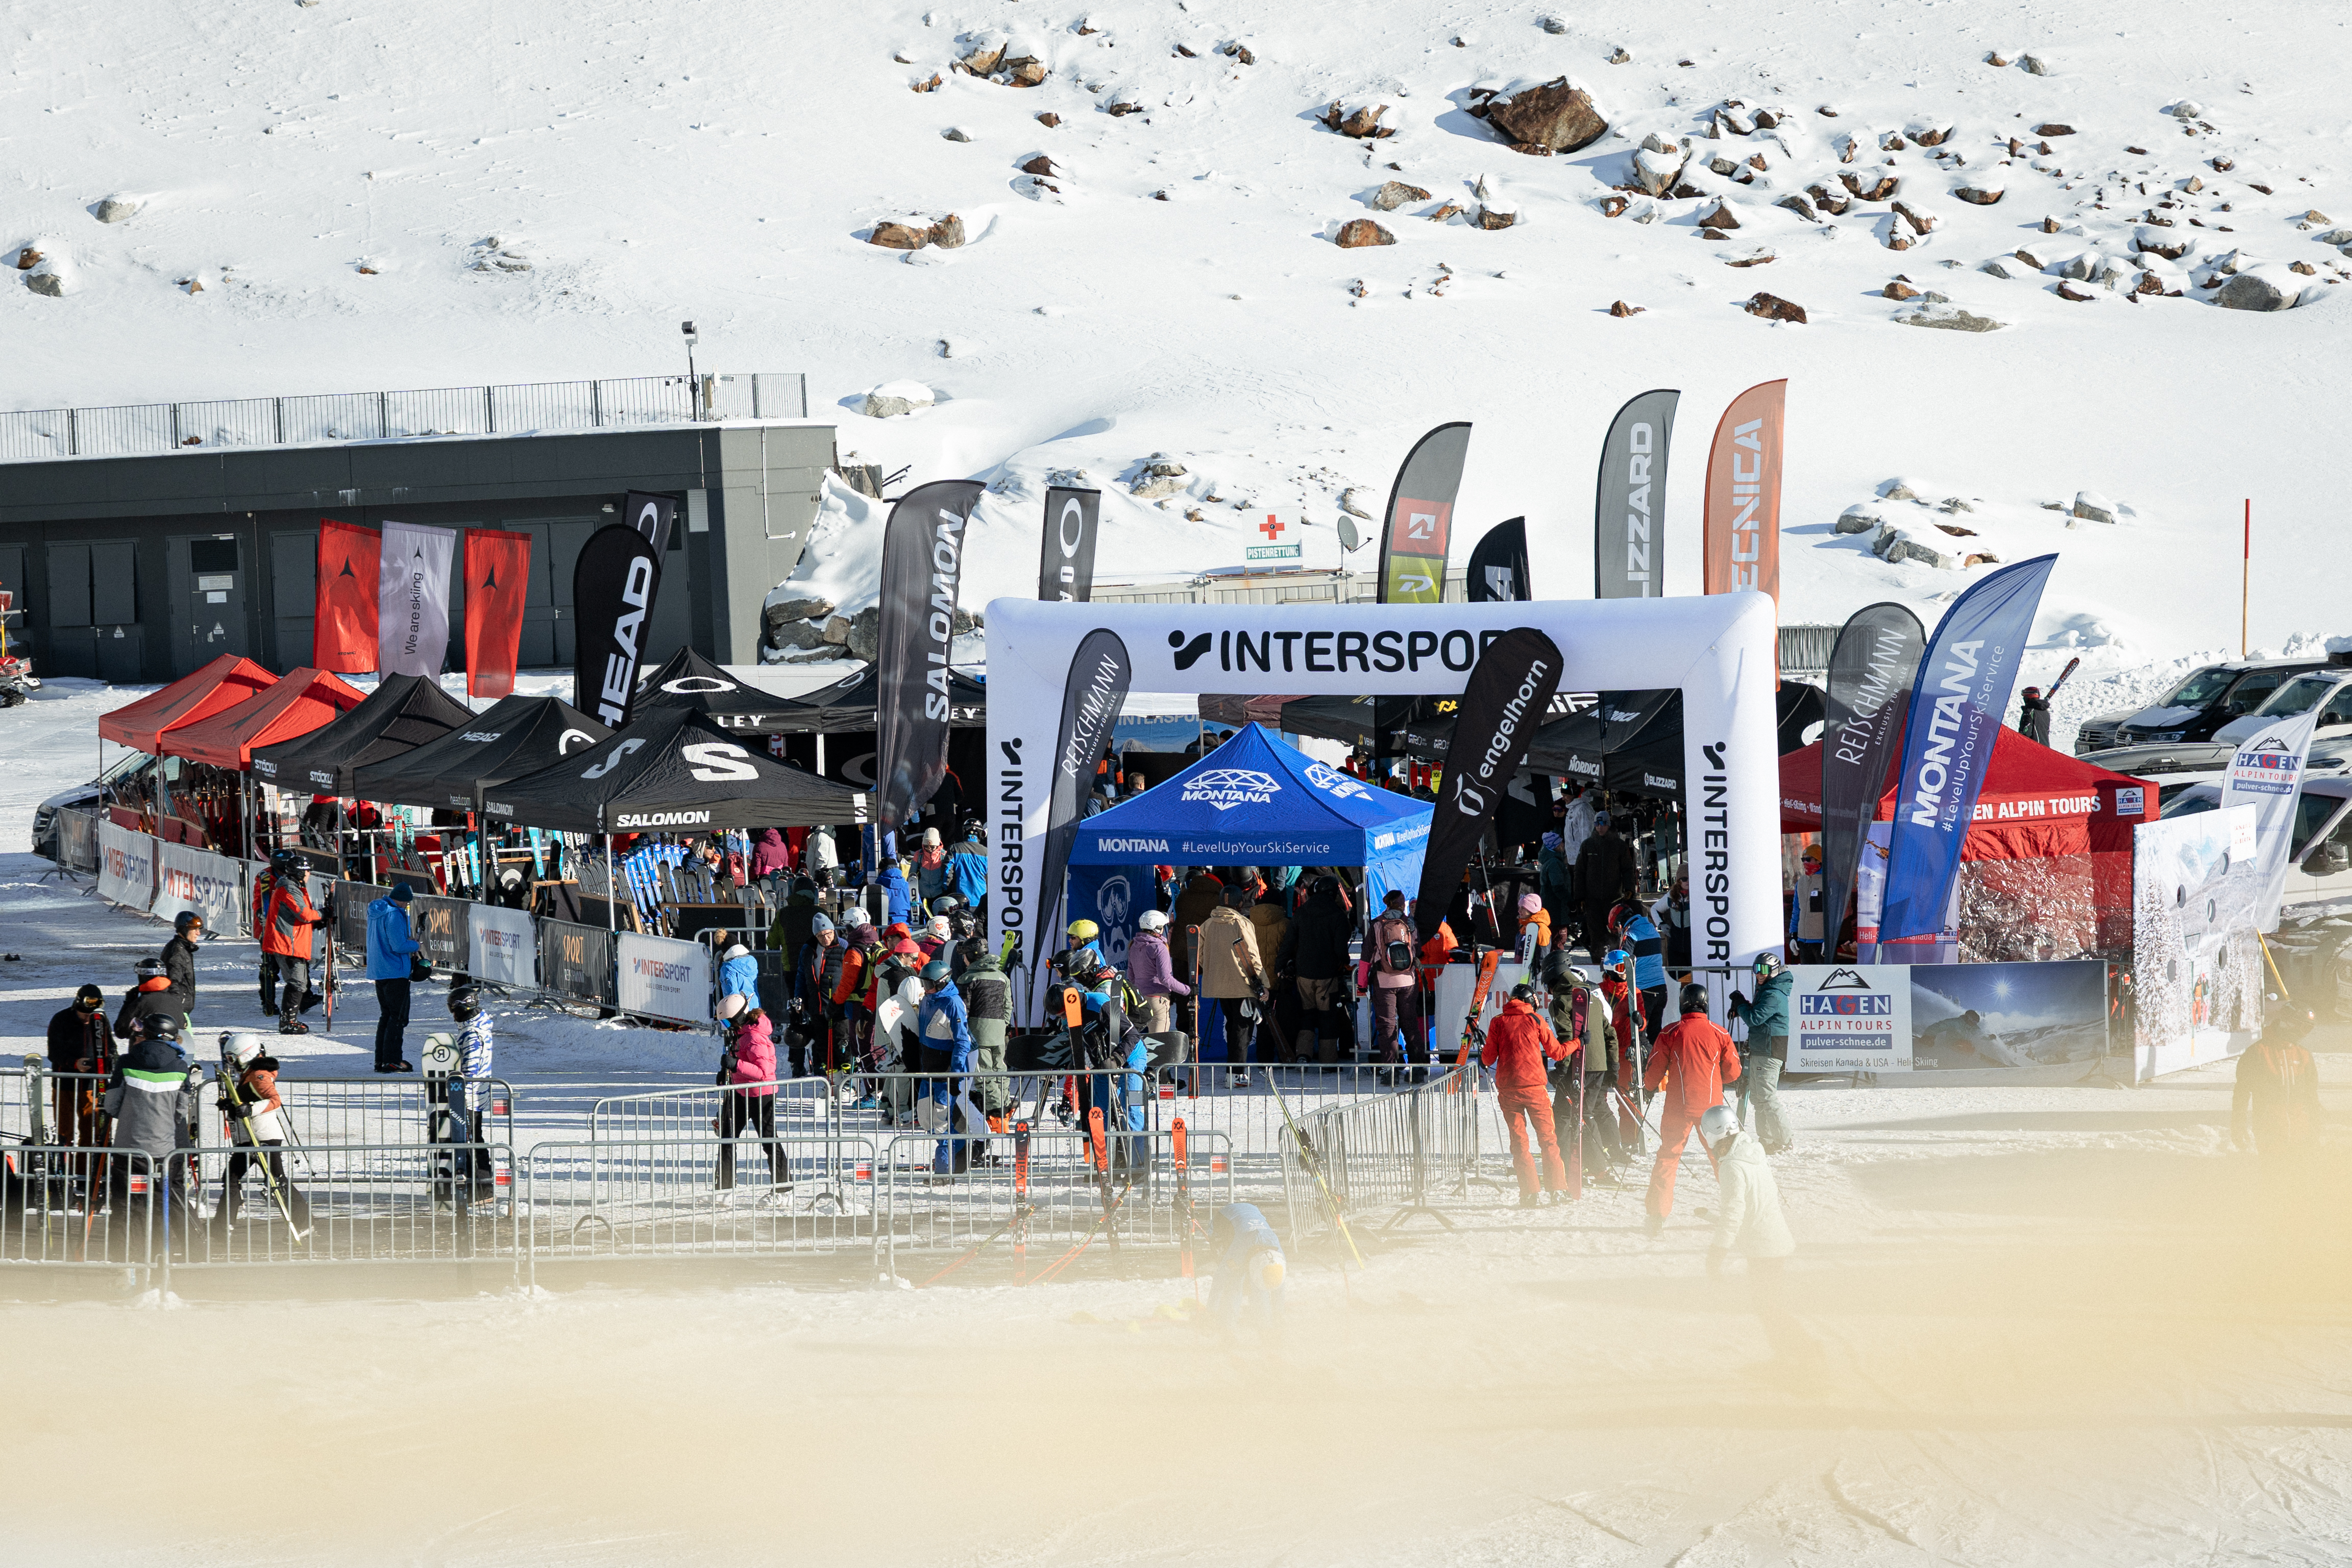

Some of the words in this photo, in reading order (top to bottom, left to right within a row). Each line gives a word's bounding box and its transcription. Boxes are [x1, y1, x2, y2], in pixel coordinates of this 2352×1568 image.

[1732, 418, 1762, 592] ECNICA
[1247, 545, 1300, 559] PISTENRETTUNG
[410, 572, 424, 610] skiing
[409, 612, 420, 632] are
[926, 509, 964, 723] SALOMON
[405, 634, 418, 655] We
[597, 556, 650, 727] HEAD
[1221, 630, 1507, 673] INTERSPO
[2059, 662, 2078, 685] ATOMIC
[1835, 628, 1907, 765] REISCHMANN
[718, 715, 763, 727] LEY
[1062, 653, 1119, 778] REISCHMANN
[1100, 713, 1109, 728] FÜR
[1480, 659, 1548, 778] engelhorn
[1875, 706, 1893, 745] EXKLUSIV
[1890, 689, 1899, 705] FÜR
[459, 731, 501, 742] HEAD
[1911, 640, 1986, 828] MONTANA
[1568, 755, 1600, 776] NORDICA
[2238, 754, 2301, 771] HAGEN
[1649, 775, 1677, 790] BLIZZARD
[2234, 770, 2265, 778] ALPIN
[450, 793, 471, 806] head.com
[1182, 790, 1271, 803] MONTANA
[486, 801, 513, 816] SALOMON
[1998, 800, 2045, 820] ALPIN
[2049, 796, 2101, 815] TOURS
[617, 811, 710, 827] SALOMON
[1098, 839, 1169, 852] MONTANA
[1182, 842, 1330, 855] #LevelUpYourSkiService
[1001, 770, 1023, 968] INTERSPOR
[1703, 775, 1730, 981] INTERSPORT
[429, 907, 452, 935] SPORT
[485, 928, 521, 950] INTERSPORT
[563, 935, 583, 964] SPORT
[641, 959, 691, 983] INTERSPORT
[1802, 995, 1890, 1015] HAGEN
[1800, 1020, 1842, 1030] ALPIN
[1847, 1020, 1892, 1030] TOURS
[95, 1020, 103, 1058] HEAD
[1805, 1037, 1886, 1048] pulver-schnee.de
[1800, 1058, 1833, 1067] Skireisen
[1835, 1058, 1863, 1067] Kanada
[1874, 1058, 1889, 1067] USA
[449, 1108, 466, 1125] völkl
